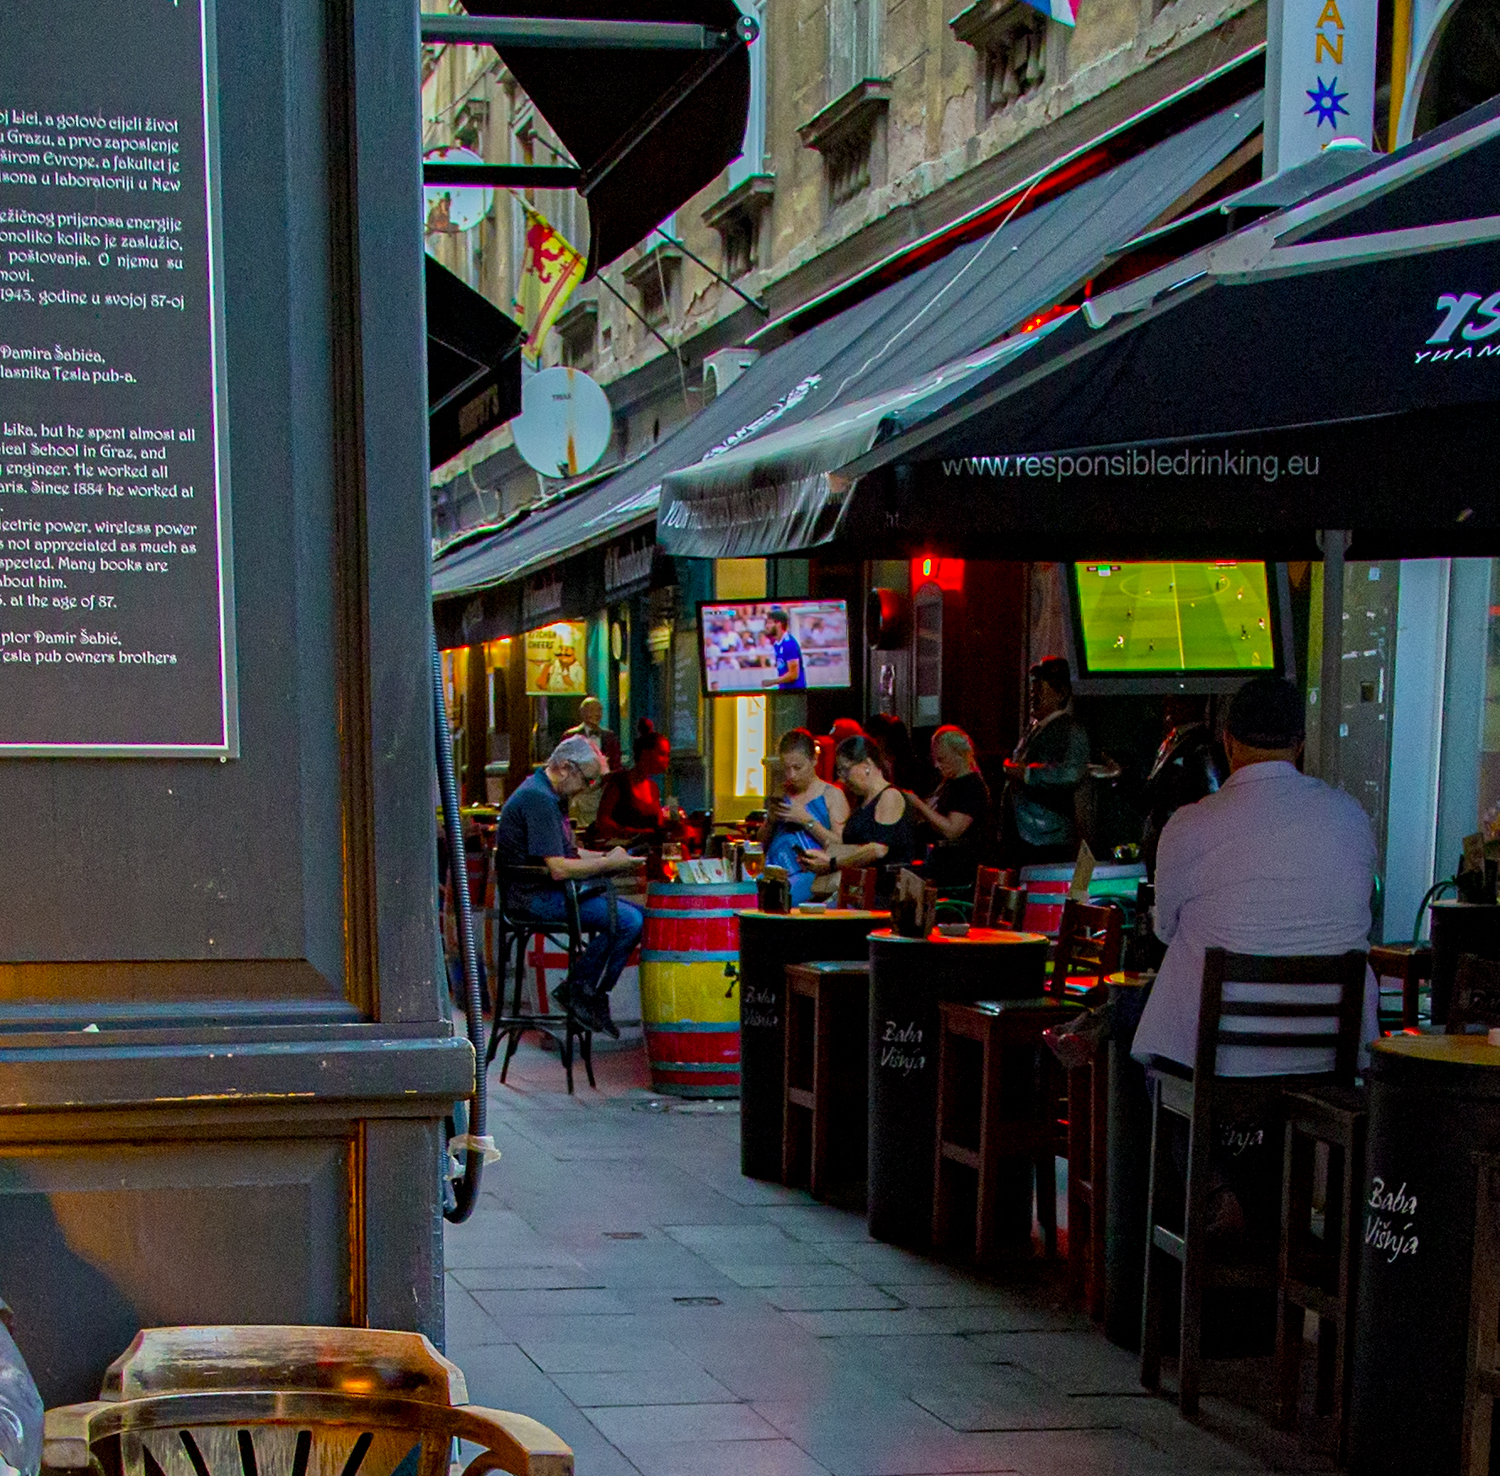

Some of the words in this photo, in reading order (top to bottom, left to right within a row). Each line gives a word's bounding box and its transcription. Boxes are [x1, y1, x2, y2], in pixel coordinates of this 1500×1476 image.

[45, 115, 54, 126] a
[56, 113, 107, 130] gotovo
[108, 116, 142, 133] cijeli
[145, 117, 178, 133] život
[41, 423, 63, 438] but
[67, 424, 84, 439] he
[88, 427, 125, 442] spent
[129, 426, 175, 441] almost
[179, 428, 195, 441] all
[30, 442, 79, 457] School
[83, 444, 96, 458] in
[140, 446, 166, 460] and
[74, 462, 94, 478] He
[97, 464, 148, 478] worked
[151, 465, 168, 478] all
[942, 449, 1319, 482] www.responsibledrinking.eu
[31, 480, 70, 496] Since
[74, 483, 104, 496] 1884
[107, 482, 125, 497] he
[128, 484, 178, 498] worked
[181, 486, 194, 498] at
[35, 649, 62, 665] pub
[65, 652, 115, 664] owners
[119, 650, 177, 665] brothers
[881, 1020, 924, 1042] Baba
[1369, 1177, 1418, 1216] Baba
[1363, 1214, 1420, 1264] Višnja
